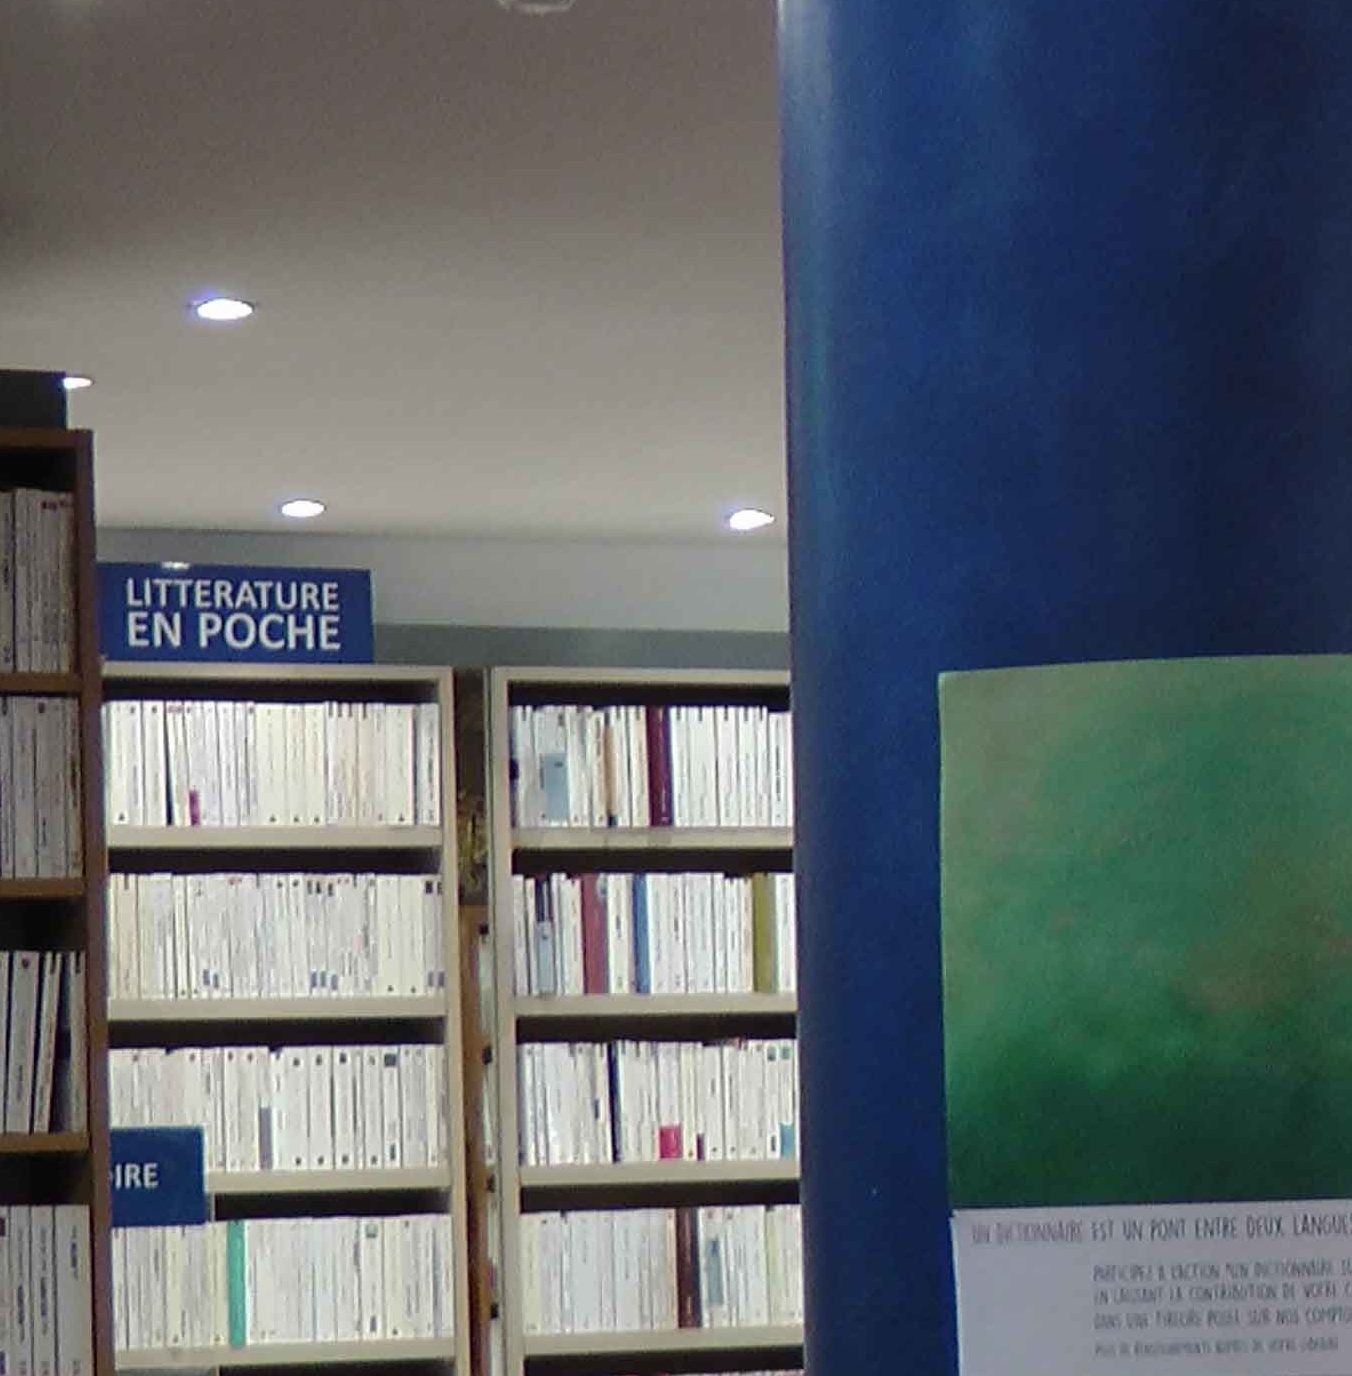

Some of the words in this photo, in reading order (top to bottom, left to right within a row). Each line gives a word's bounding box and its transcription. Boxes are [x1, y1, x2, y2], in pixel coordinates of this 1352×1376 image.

[127, 577, 339, 611] LITTERATURE
[128, 611, 181, 647] EN
[200, 612, 341, 651] POCHE
[109, 1162, 159, 1190] IRE
[1091, 1218, 1114, 1242] EST
[1122, 1217, 1143, 1242] UN
[1149, 1217, 1186, 1242] PONT
[1194, 1215, 1238, 1240] ENTRE
[1246, 1214, 1284, 1238] DEUX
